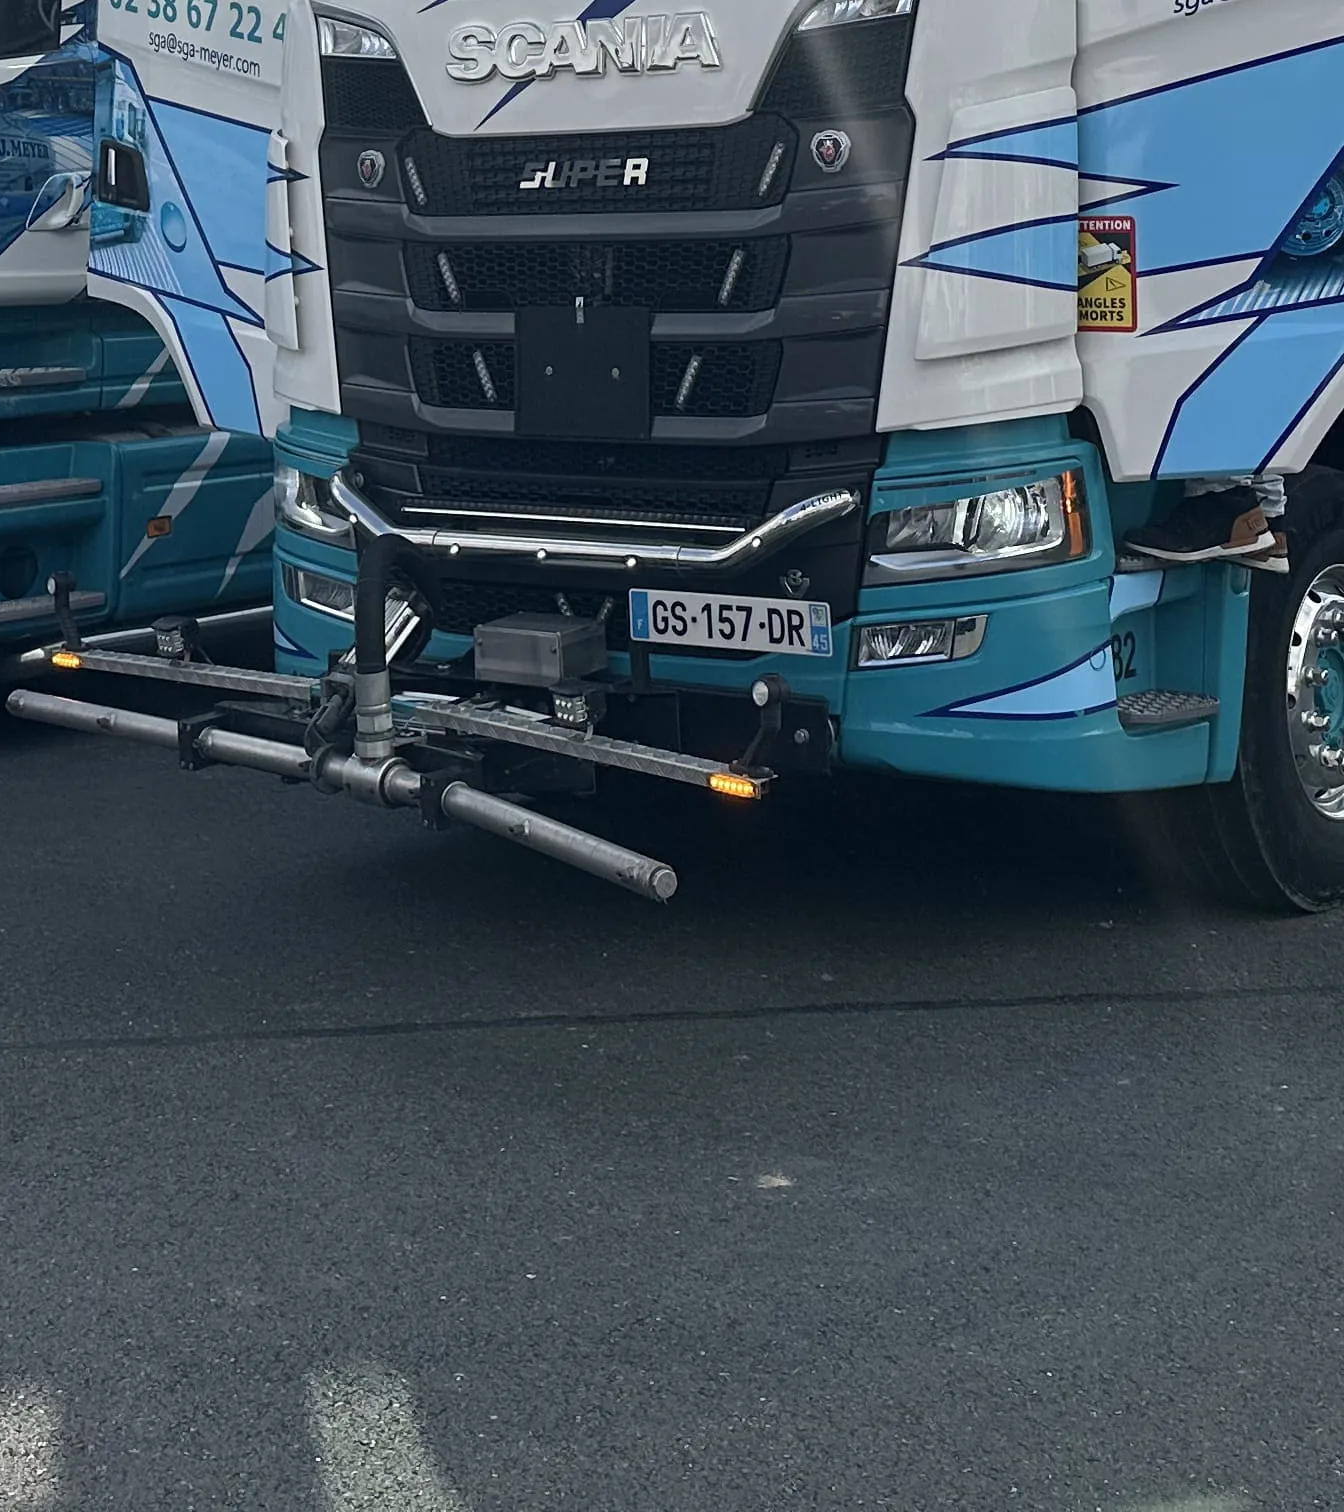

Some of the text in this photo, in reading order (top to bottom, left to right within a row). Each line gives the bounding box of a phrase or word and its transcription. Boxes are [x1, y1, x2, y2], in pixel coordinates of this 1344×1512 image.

[230, 2, 263, 44] 22
[272, 13, 286, 45] 4
[148, 31, 261, 78] sga@sga-meyer.com
[446, 12, 722, 84] SCANIA
[519, 157, 649, 189] SUPER
[1080, 220, 1131, 230] TENTION
[1078, 297, 1126, 309] ANGLES
[1080, 310, 1124, 322] MORTS
[813, 634, 828, 651] 45
